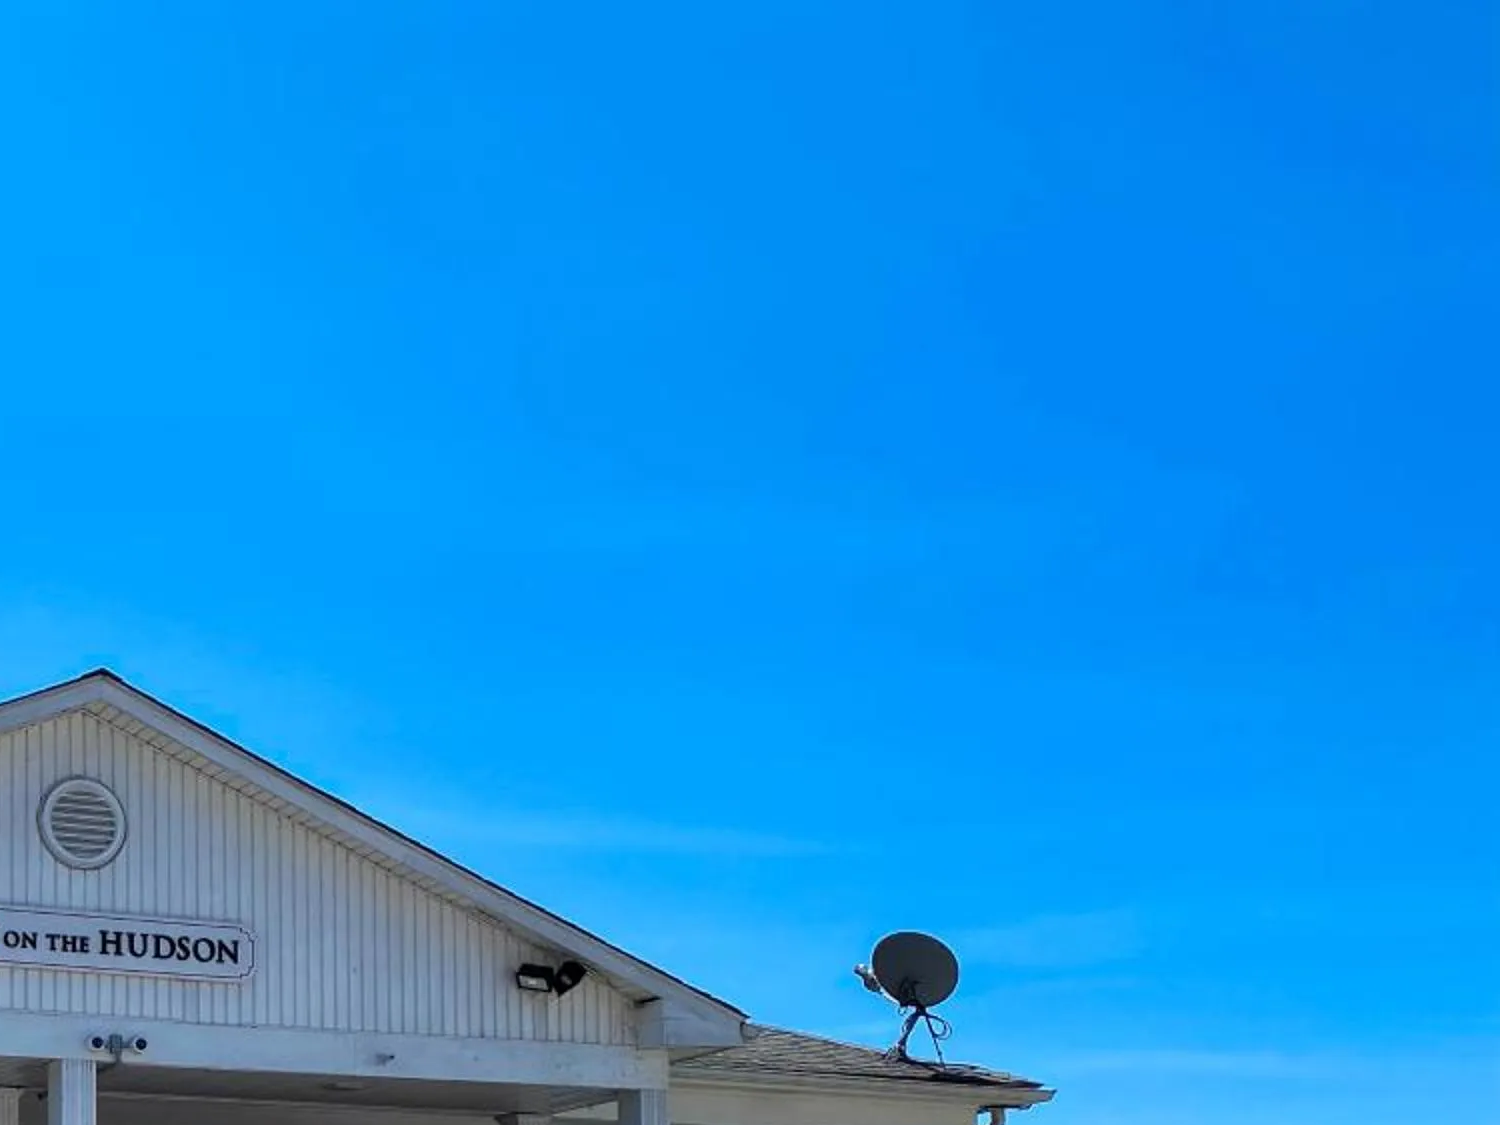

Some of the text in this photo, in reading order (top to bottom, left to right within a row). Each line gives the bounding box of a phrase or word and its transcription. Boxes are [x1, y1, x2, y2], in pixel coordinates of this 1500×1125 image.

[2, 930, 37, 950] ON
[45, 933, 89, 953] THE
[98, 929, 239, 964] HUDSON
